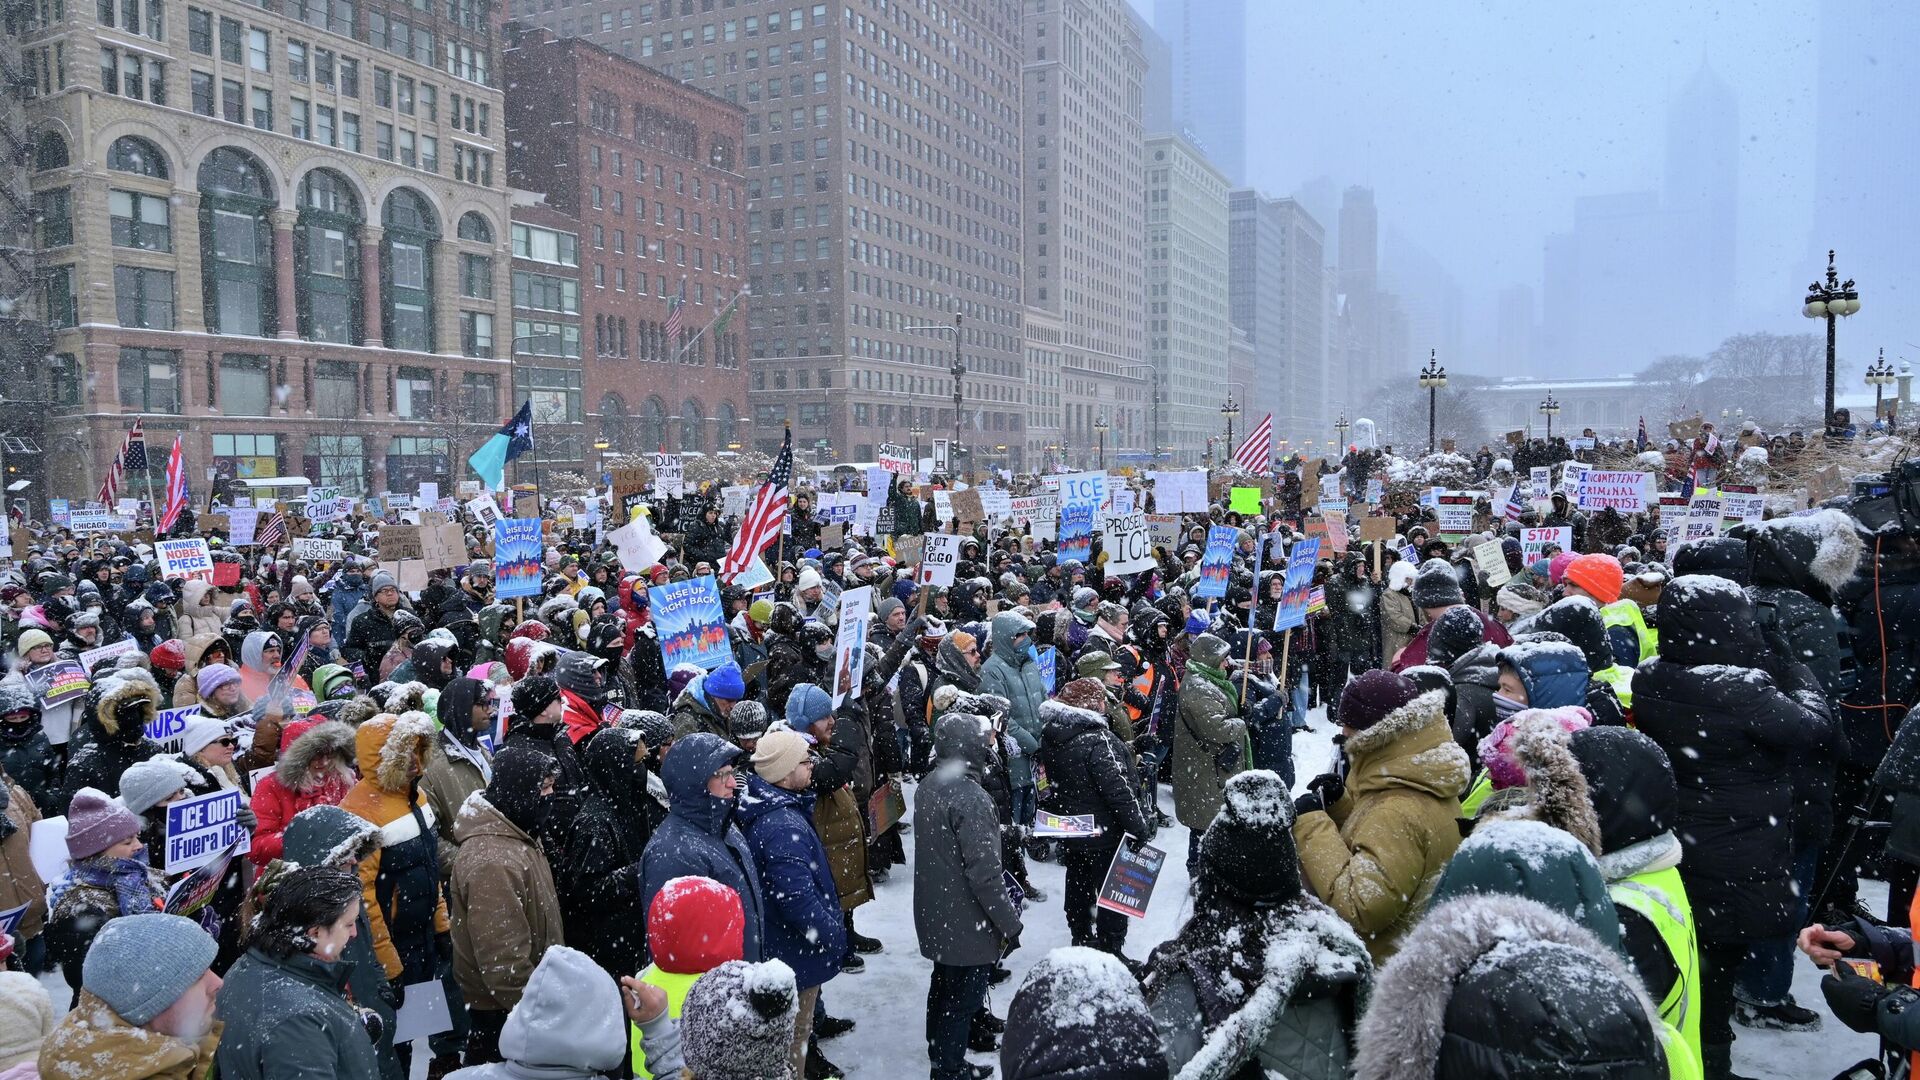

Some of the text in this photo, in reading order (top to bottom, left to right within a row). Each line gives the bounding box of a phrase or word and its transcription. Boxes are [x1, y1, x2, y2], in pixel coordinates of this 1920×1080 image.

[656, 455, 682, 467] DUMP
[619, 470, 638, 480] ICE
[656, 468, 682, 478] TRUMP
[1581, 472, 1643, 484] INCOMPETENT
[1067, 478, 1104, 499] ICE
[311, 487, 340, 503] STOP
[626, 494, 647, 505] Wake
[1012, 498, 1038, 509] ABOLIS
[1580, 496, 1639, 509] ENTERPRISE
[1692, 500, 1721, 510] JUSTICE
[307, 502, 338, 518] CHILD
[1034, 507, 1054, 520] ICE
[73, 521, 107, 530] CHICAGO
[505, 525, 534, 535] RISE UP
[500, 534, 539, 546] FIGHT BACK
[1528, 528, 1560, 541] STOP
[162, 540, 201, 551] WINNER
[303, 540, 333, 550] FIGHT
[1113, 529, 1150, 564] ICE
[165, 549, 204, 560] NOBEL
[168, 557, 207, 571] PIECE
[664, 586, 706, 602] RISE UP
[659, 596, 717, 616] FIGHT BACK
[55, 687, 65, 695] OUT
[181, 795, 237, 832] ICE OUT!
[170, 832, 219, 863] ¡Fuera
[1121, 851, 1157, 871] ICE IS MELTING
[1109, 889, 1140, 908] TYRANNY
